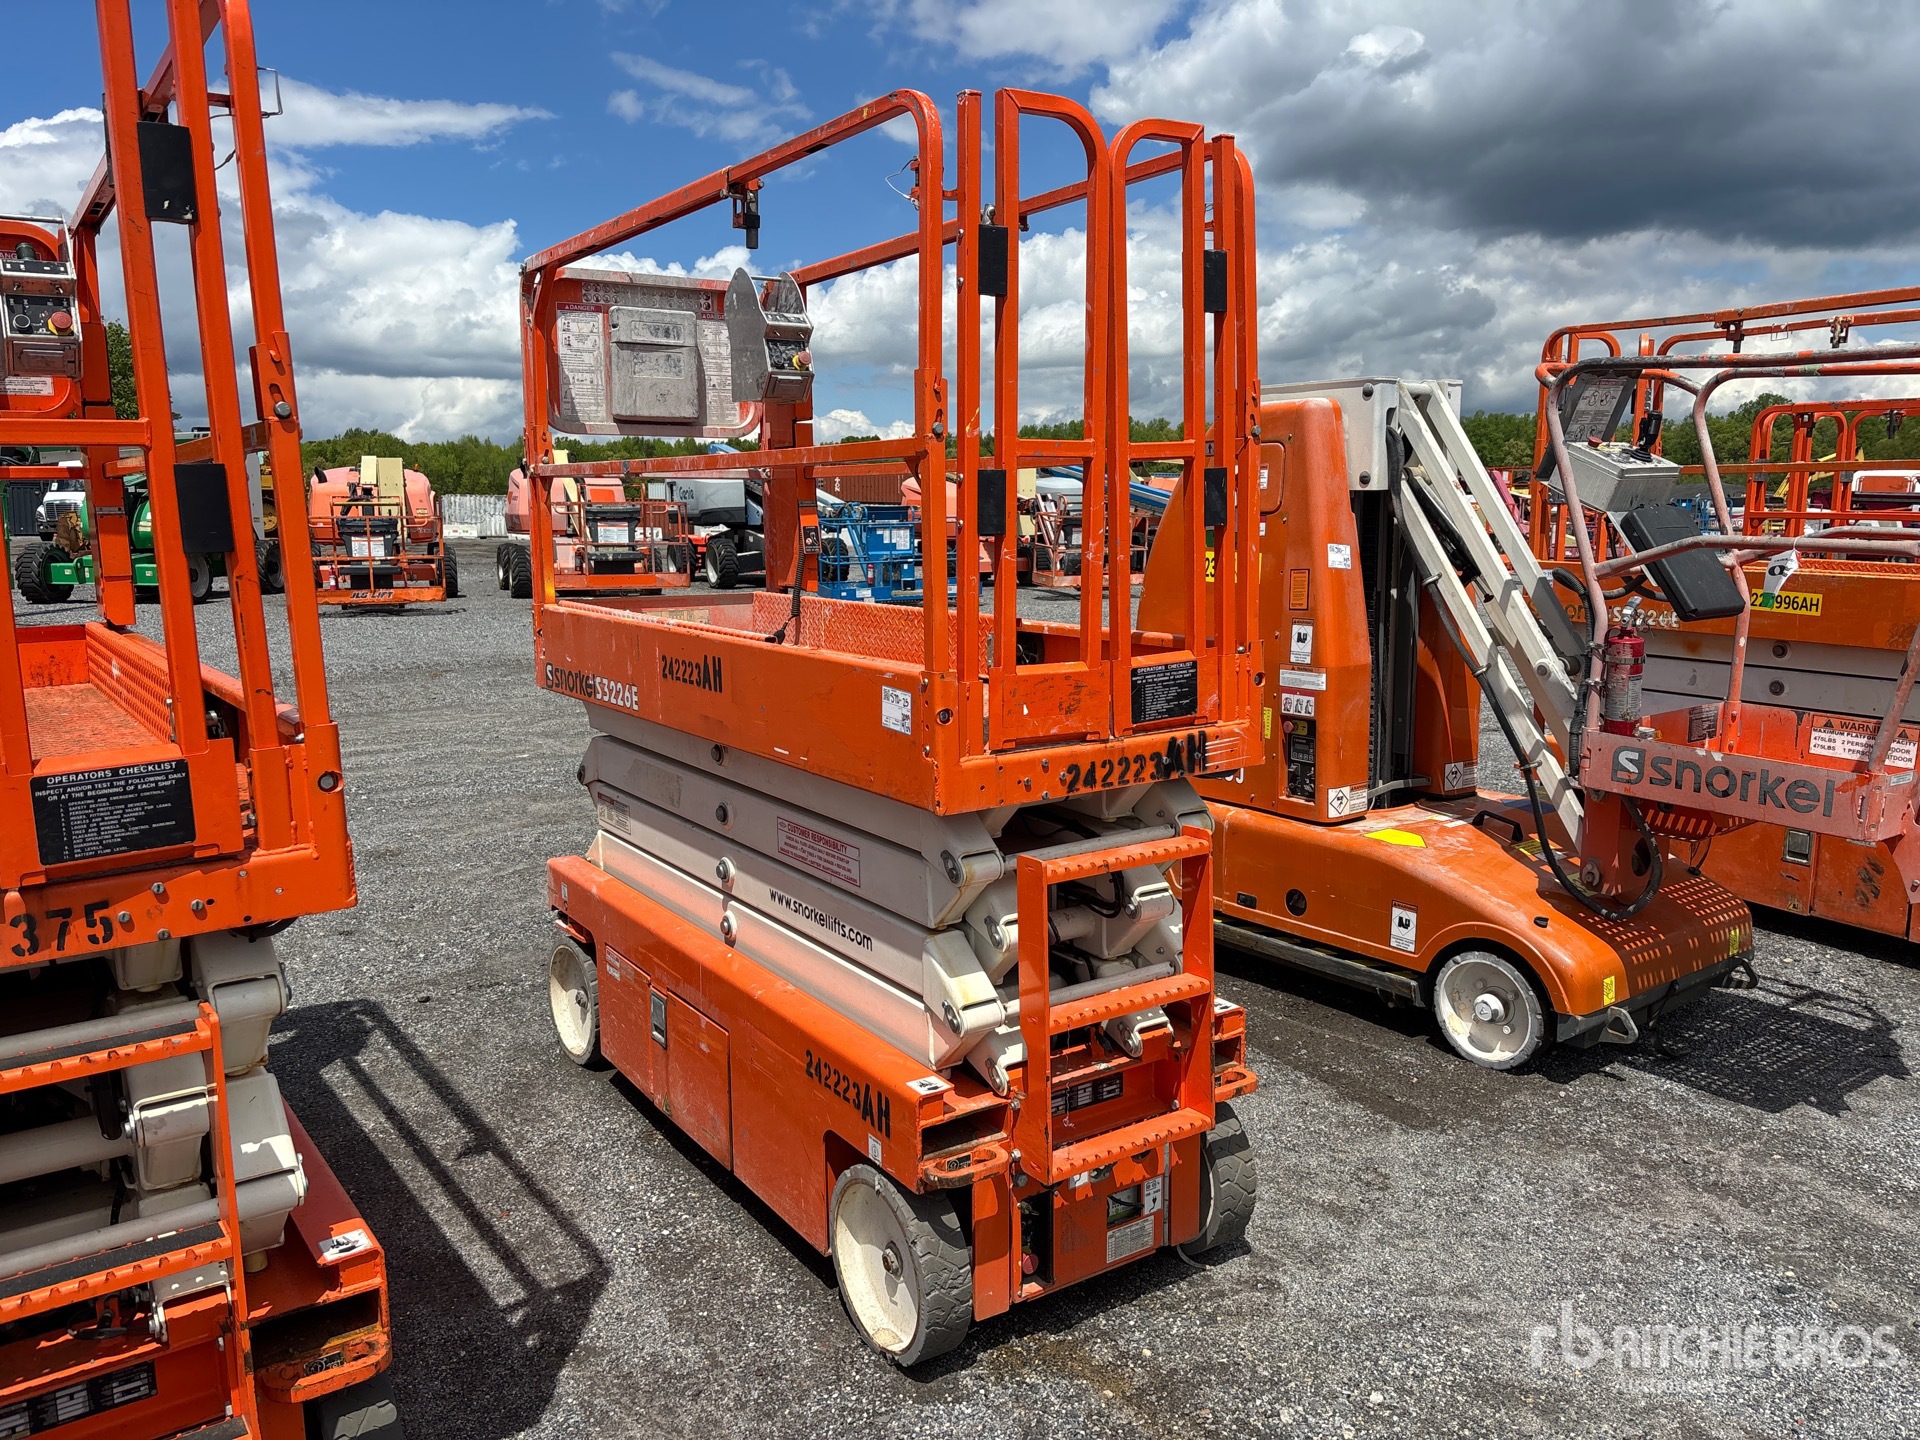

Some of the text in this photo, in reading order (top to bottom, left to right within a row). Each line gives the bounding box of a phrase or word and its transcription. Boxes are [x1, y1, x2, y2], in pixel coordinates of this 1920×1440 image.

[1751, 592, 1820, 613] 22996AH
[661, 654, 723, 694] 242223AH
[1137, 665, 1165, 673] OPERATORS
[595, 676, 639, 711] S3226E
[1813, 728, 1845, 736] MAXIMUM
[1840, 721, 1880, 734] WARNI
[1066, 730, 1207, 794] 242223AH
[1887, 755, 1913, 763] TDOOR
[1891, 747, 1911, 755] DOOR
[47, 761, 177, 784] OPERATORS CHECKLIST
[35, 788, 63, 797] INSPECT
[67, 785, 92, 793] AND/OR
[129, 775, 166, 784] FOLLOWING
[88, 787, 123, 796] BEGINNING
[1649, 755, 1836, 818] snorkel
[788, 823, 847, 854] CUSTOMER RESPONSIBILITY
[9, 899, 114, 957] 375
[769, 888, 873, 952] www.snorkellifts.com
[805, 1049, 890, 1139] 242223AH
